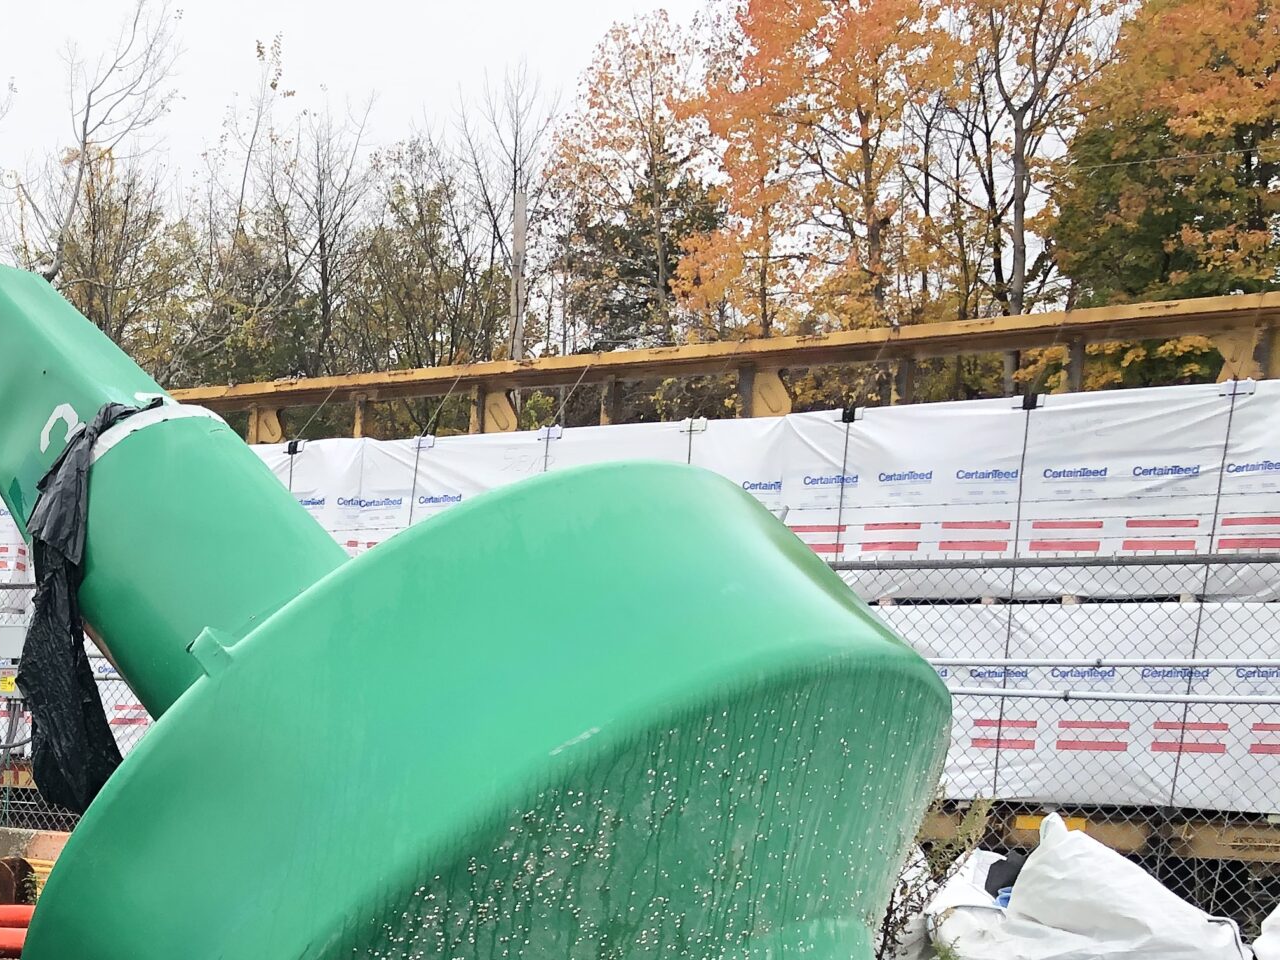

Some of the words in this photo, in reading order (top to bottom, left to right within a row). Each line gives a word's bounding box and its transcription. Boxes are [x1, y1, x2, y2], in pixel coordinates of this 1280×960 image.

[1132, 465, 1200, 477] CertainTeed
[1226, 460, 1280, 474] CertainTee
[878, 470, 933, 482] CertainTeed
[956, 469, 1019, 480] CertainTeed
[1043, 467, 1108, 479] CertainTeed
[803, 475, 859, 486] CertainTeed
[359, 498, 403, 508] CertainTeed
[418, 494, 462, 505] CertainTeed
[1051, 667, 1116, 678] CertainTeed
[1141, 667, 1210, 678] CertainTeed
